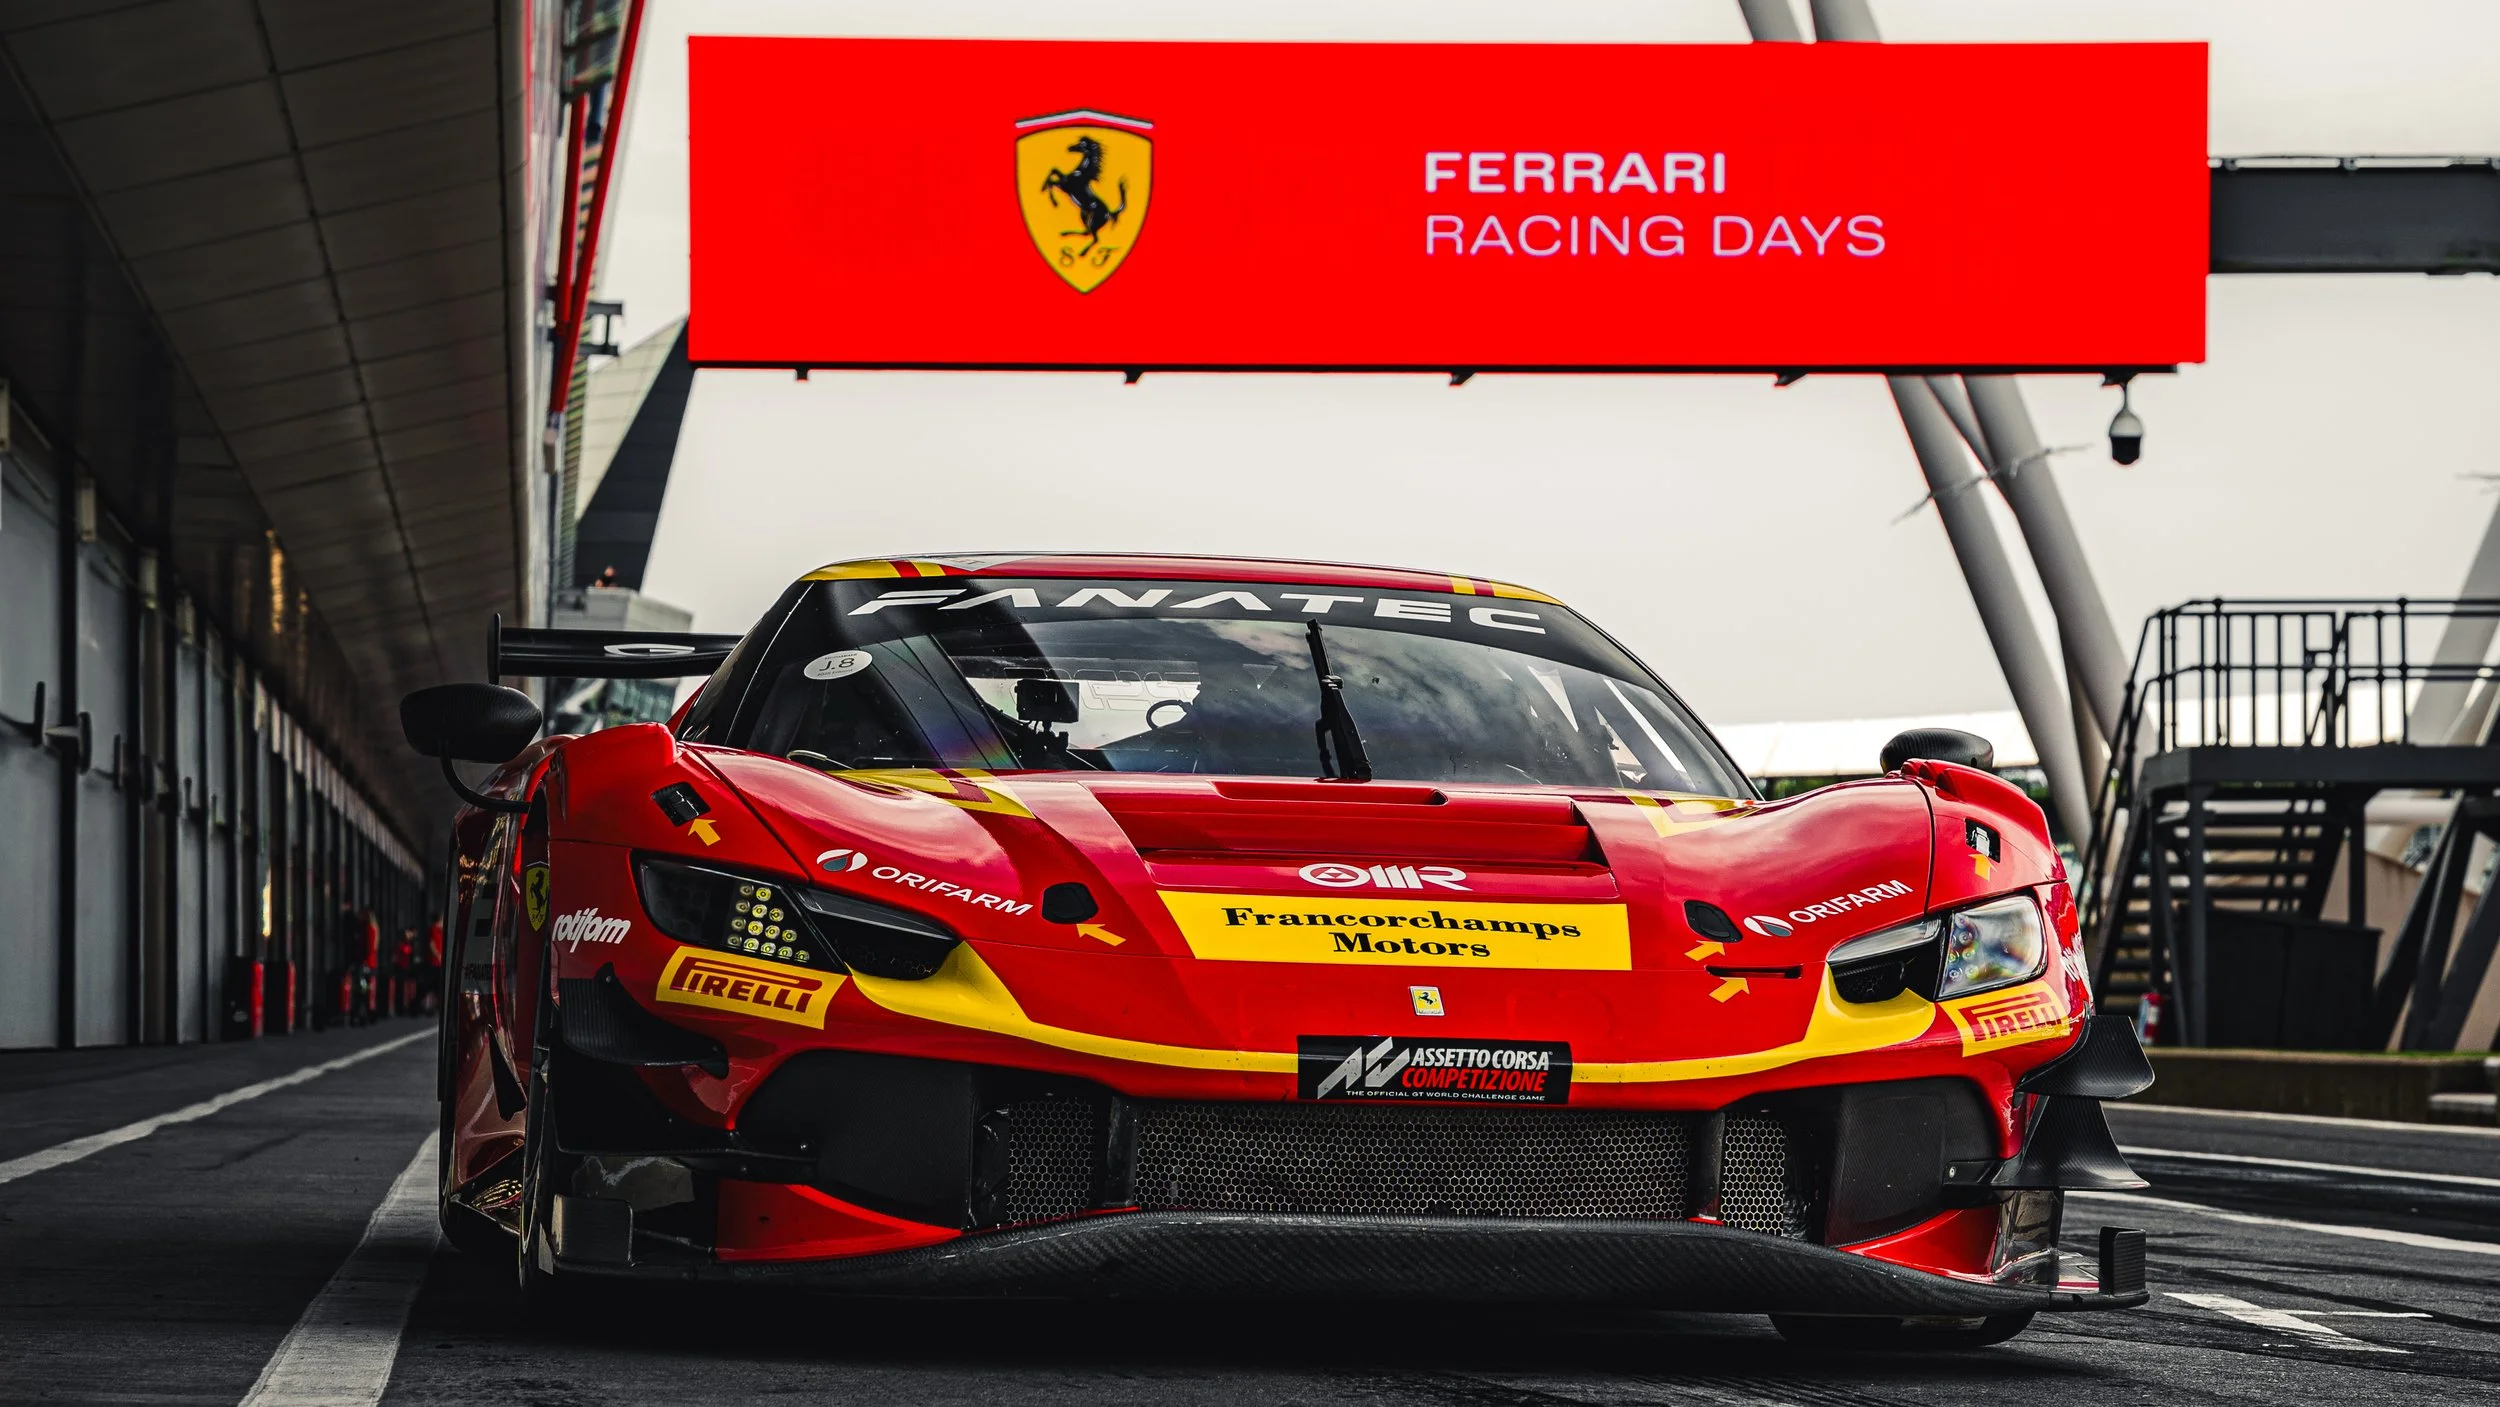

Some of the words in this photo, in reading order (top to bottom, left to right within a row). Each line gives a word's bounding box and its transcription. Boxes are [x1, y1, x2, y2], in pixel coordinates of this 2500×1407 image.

[1425, 152, 1726, 193] FERRARI
[1426, 215, 1685, 256] RACING
[1713, 215, 1886, 256] DAYS
[847, 586, 1547, 635] FANATEC
[819, 657, 855, 672] J.8
[872, 866, 1034, 917] ORIFARM
[1788, 879, 1914, 923] ORIFARM
[552, 907, 631, 953] rotiform
[1221, 907, 1582, 941] Francorchamps
[1329, 932, 1491, 958] Motors
[669, 956, 823, 1014] PIRELLI
[1958, 991, 2062, 1042] PIRELLI
[1401, 1067, 1548, 1092] COMPETIZIONE
[1411, 1047, 1491, 1068] ASSETTO
[1491, 1049, 1549, 1071] CORSA
[1461, 1092, 1518, 1100] CHALLENGE
